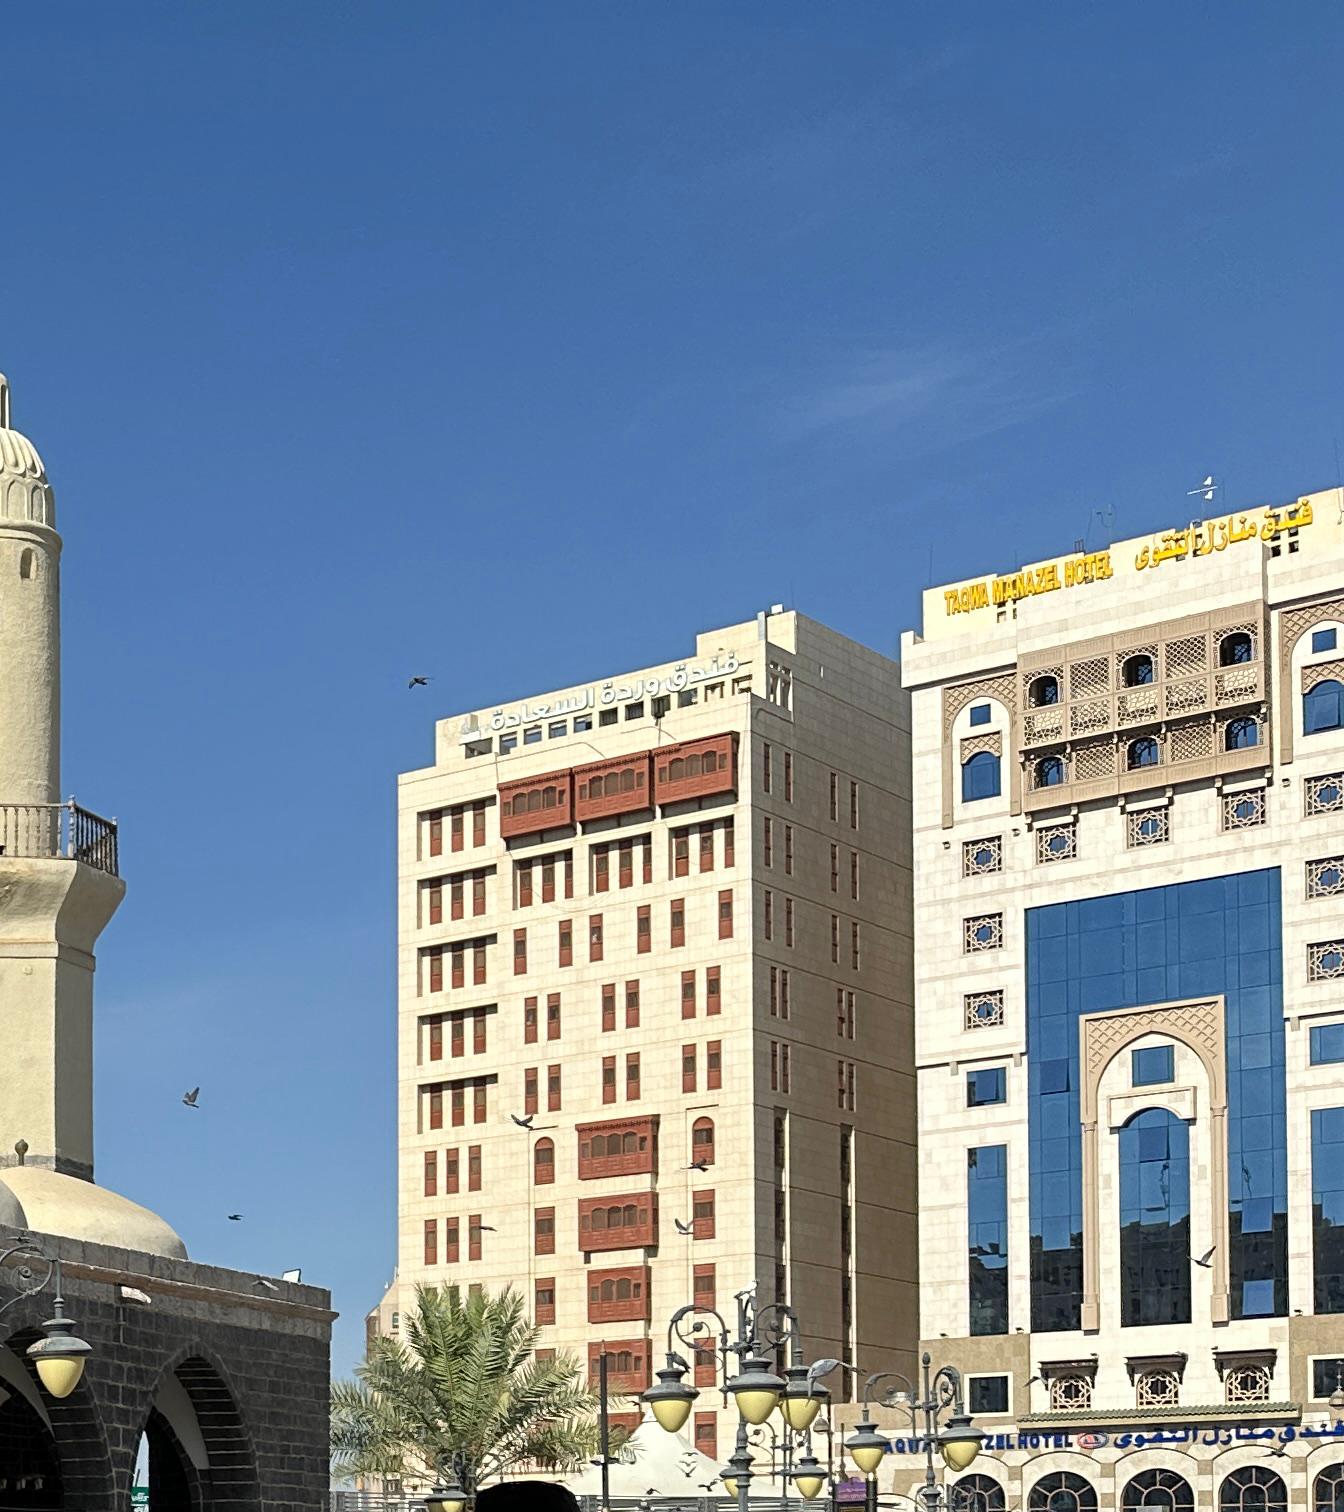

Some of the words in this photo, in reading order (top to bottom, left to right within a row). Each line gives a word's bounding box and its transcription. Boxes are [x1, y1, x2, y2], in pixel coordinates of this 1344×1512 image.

[1200, 514, 1257, 555] منازل
[1260, 499, 1314, 541] فندق
[1135, 528, 1196, 571] التقوى
[944, 579, 990, 617] TAQWA
[992, 563, 1061, 606] MANAZEL
[1065, 551, 1114, 589] HOTEL
[601, 675, 662, 706] وردة
[667, 652, 740, 693] فندق
[490, 686, 596, 732] السعادة
[1018, 1432, 1074, 1451] HOTEL
[1114, 1425, 1198, 1449] التقوى
[1202, 1424, 1276, 1446] منازل
